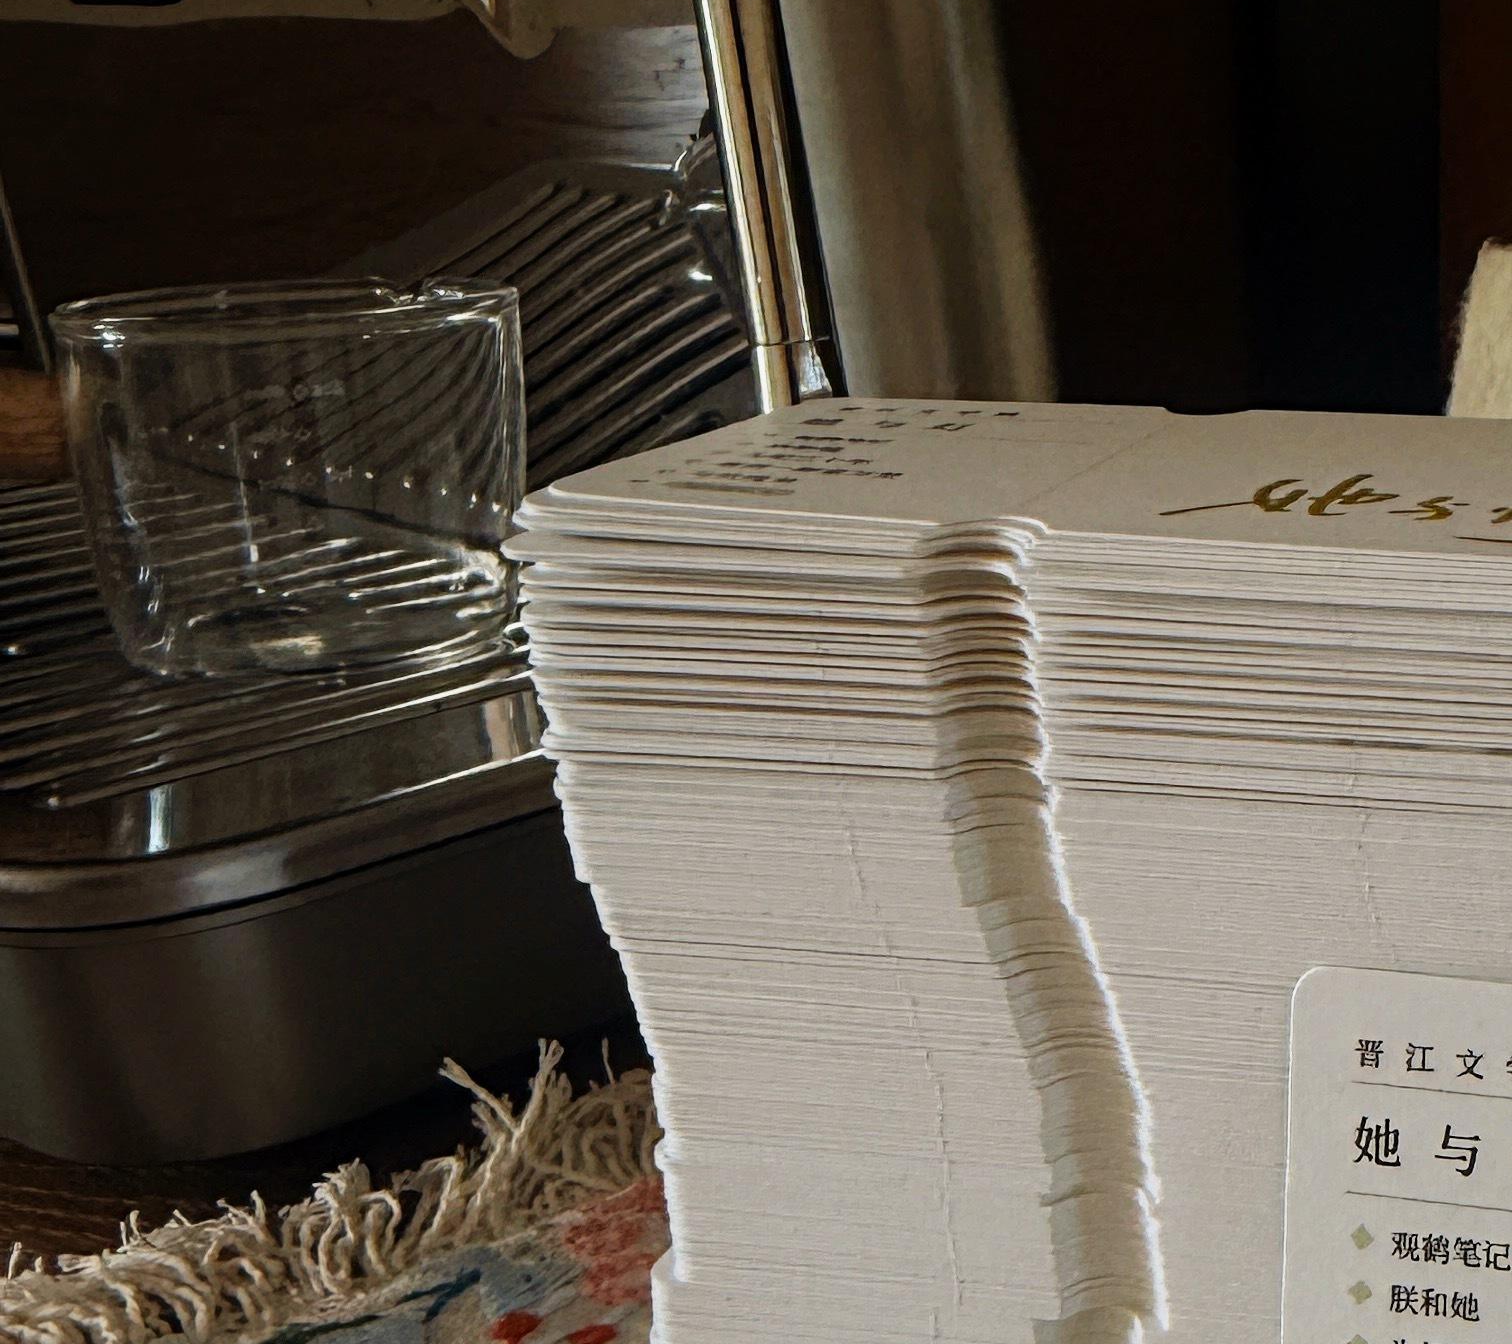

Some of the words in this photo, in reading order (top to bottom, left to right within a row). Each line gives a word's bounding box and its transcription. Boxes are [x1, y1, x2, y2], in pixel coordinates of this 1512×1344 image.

[1390, 1231, 1512, 1272] 观鹤笔记
[1388, 1284, 1481, 1323] 朕和她
